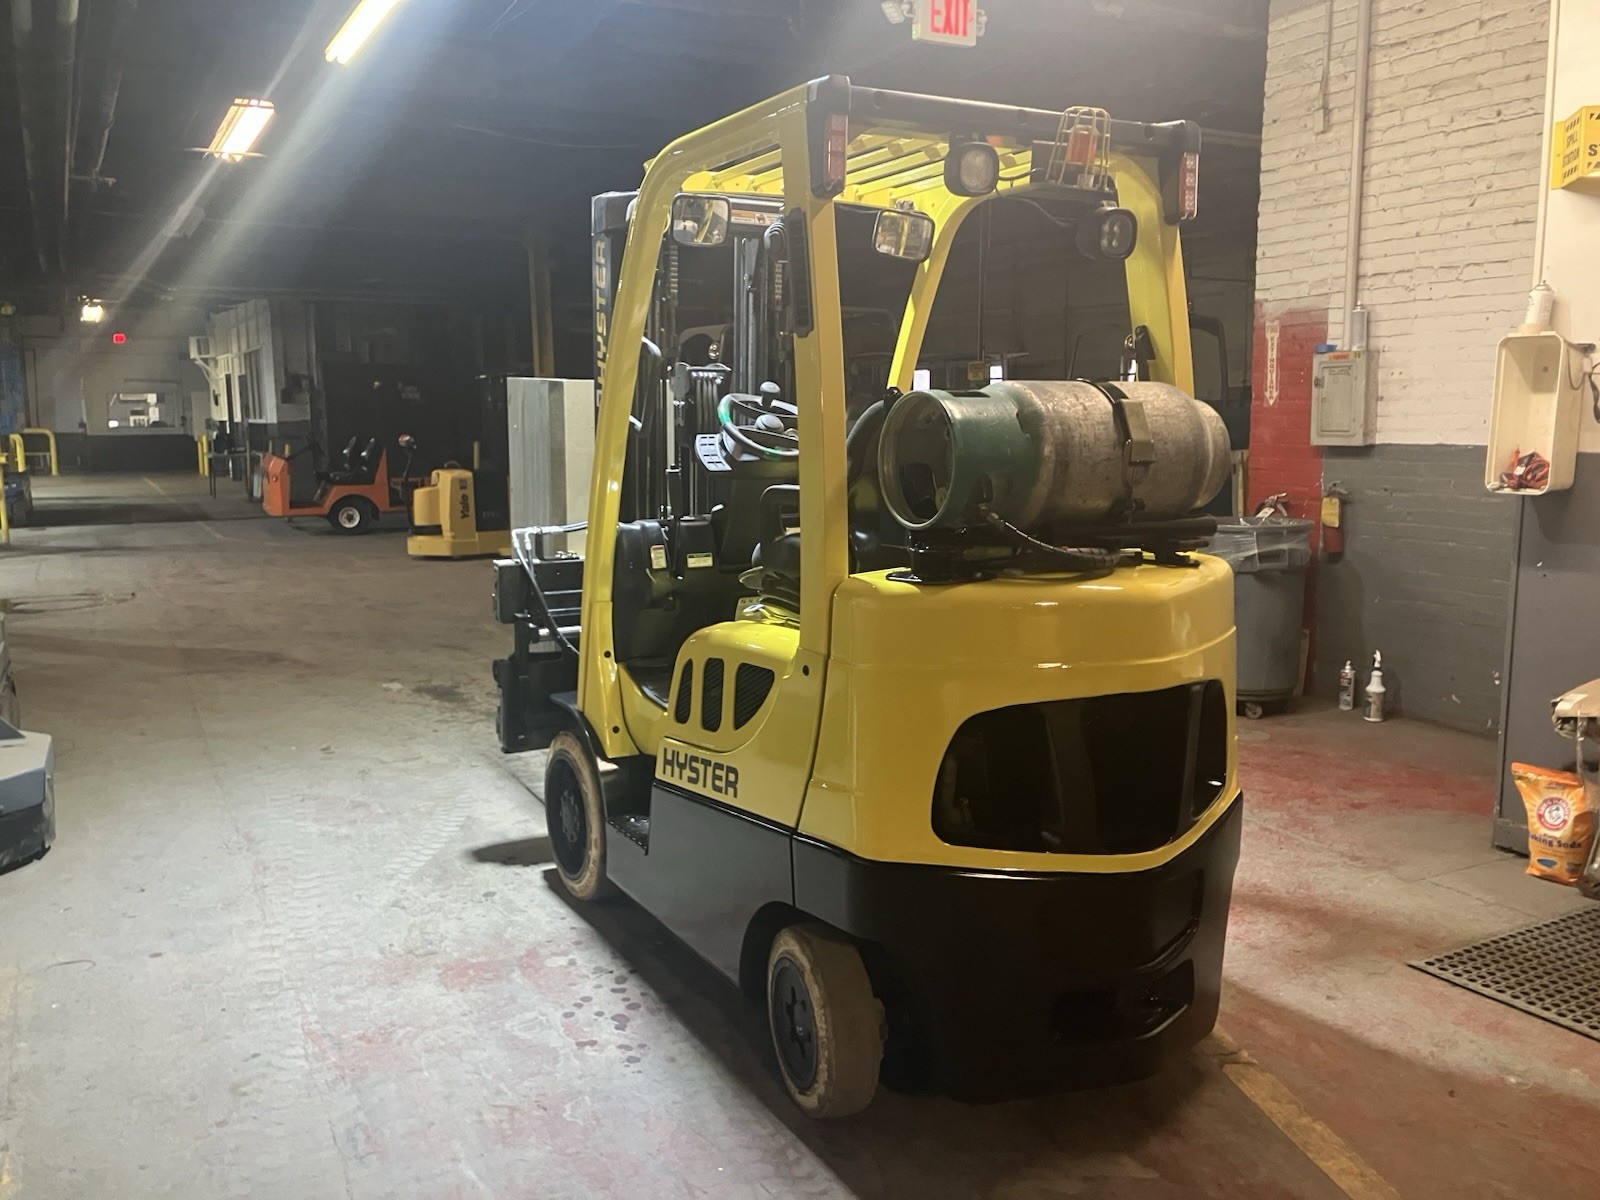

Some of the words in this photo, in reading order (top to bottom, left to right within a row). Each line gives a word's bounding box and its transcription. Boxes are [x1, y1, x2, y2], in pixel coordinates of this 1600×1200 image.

[930, 0, 970, 37] EXIT
[461, 493, 469, 519] Yale
[662, 747, 739, 798] HYSTER
[1530, 834, 1554, 848] aking
[1557, 839, 1582, 849] Soda
